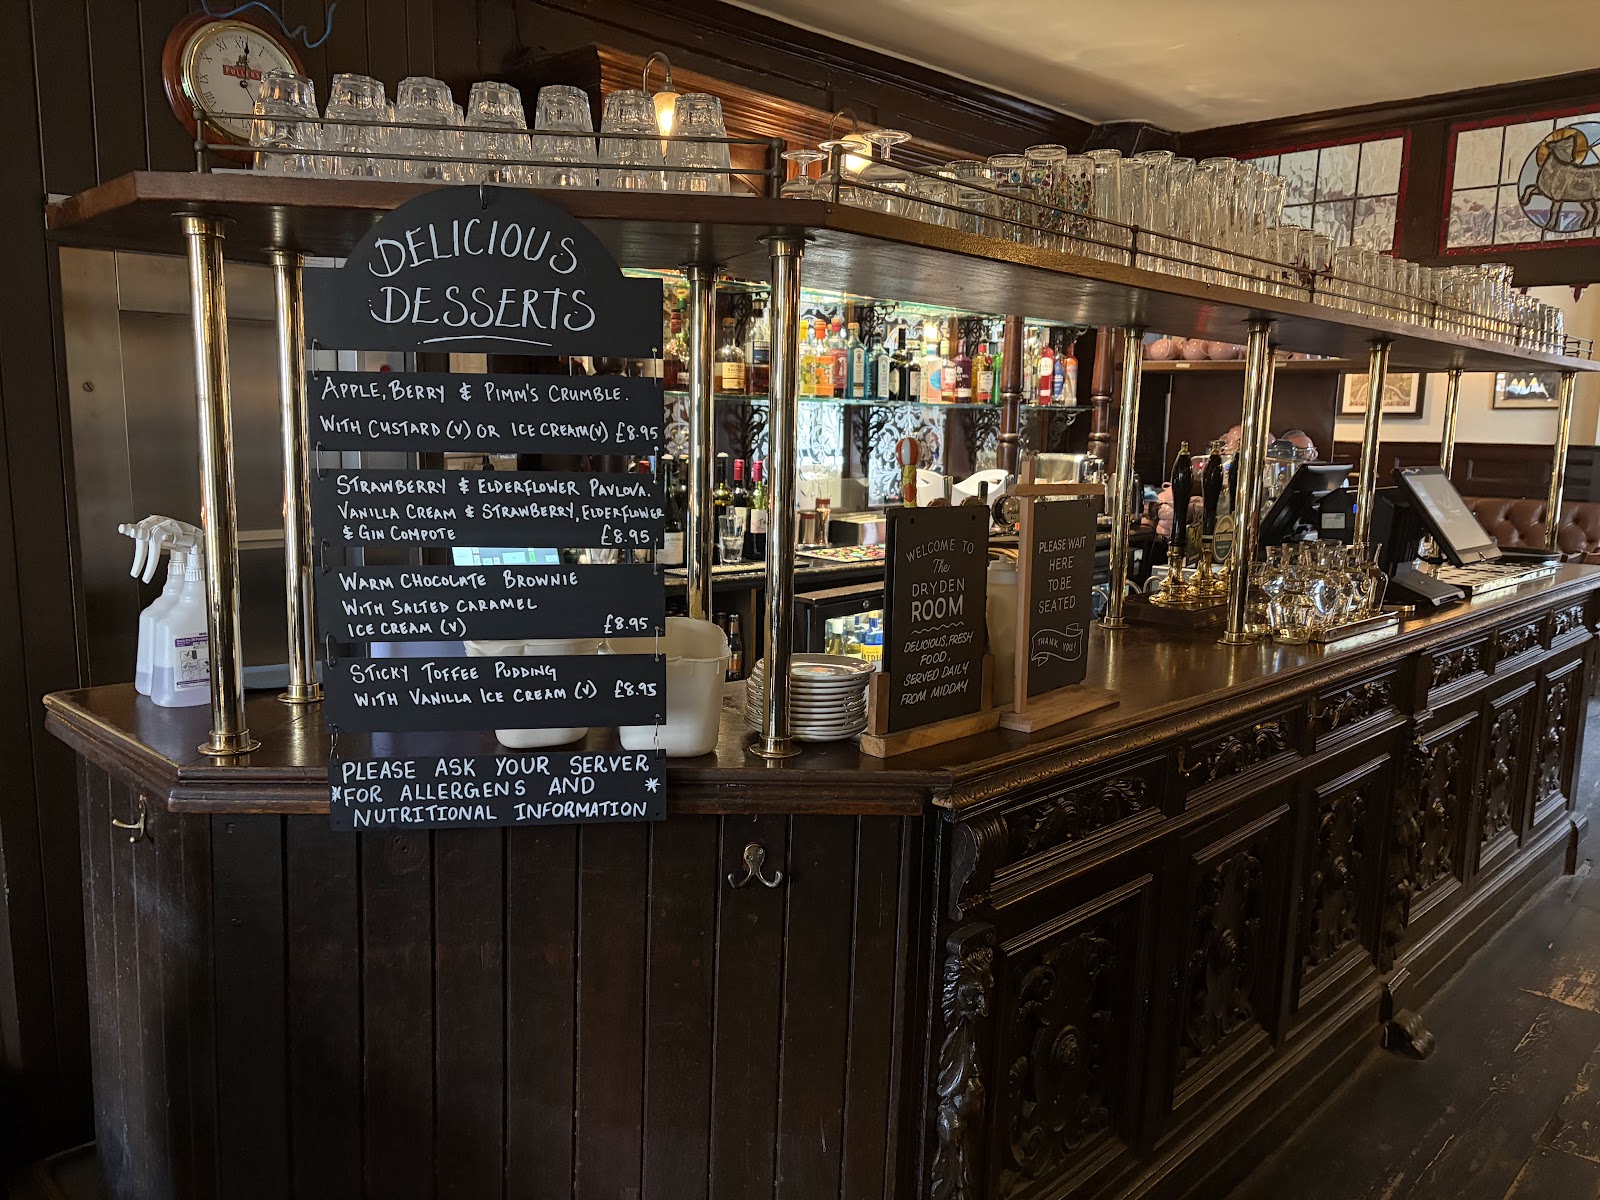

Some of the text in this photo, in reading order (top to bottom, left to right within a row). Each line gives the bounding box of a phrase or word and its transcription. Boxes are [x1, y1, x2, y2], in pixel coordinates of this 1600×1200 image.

[369, 218, 577, 277] DELICIOUS
[369, 286, 595, 331] DESSERTS
[459, 382, 471, 401] &
[484, 382, 538, 402] PIMM'S
[549, 385, 628, 402] CRUMBLE.
[320, 415, 361, 434] WITH
[369, 420, 440, 438] CUSTARD
[447, 420, 471, 440] (V)
[477, 424, 500, 438] OR
[512, 423, 535, 437] ICE
[616, 422, 658, 443] £8.95
[337, 475, 650, 497] STRAWBERRY & ELDERFLOWER PAVLOVA.
[338, 502, 399, 519] VANILLA
[406, 504, 456, 519] CREAM
[465, 505, 474, 518] &
[582, 505, 664, 523] ELDERFLOWER
[343, 524, 649, 545] & GIN COMPOTE £8.95
[1039, 536, 1086, 553] PLEASE WAIT
[906, 539, 973, 563] WELCOME TO
[933, 559, 950, 573] The
[1049, 556, 1074, 570] HERE
[339, 570, 577, 590] WARM CHOCOLATE BROWNIE
[913, 578, 964, 598] DRYDEN
[1048, 576, 1071, 592] TO BE
[342, 598, 537, 616] WITH SALTED CARAMEL
[912, 594, 963, 623] ROOM
[1039, 596, 1075, 613] SEATED
[348, 614, 648, 637] ICE CREAM (V) £8.95
[1038, 637, 1076, 653] THANK YOU!
[350, 661, 556, 683] STICKY TOFFEE PUDDING
[904, 661, 969, 686] SERVED DAILY
[354, 680, 657, 706] WITH VANILLA ICE CREAM (V) £8.95
[901, 678, 968, 705] FROM MIDDAY
[342, 754, 649, 783] PLEASE ASK YOUR SERVER
[344, 777, 594, 807] FOR ALLERGENS AND
[354, 801, 646, 827] NUTRITIONAL INFORMATION
